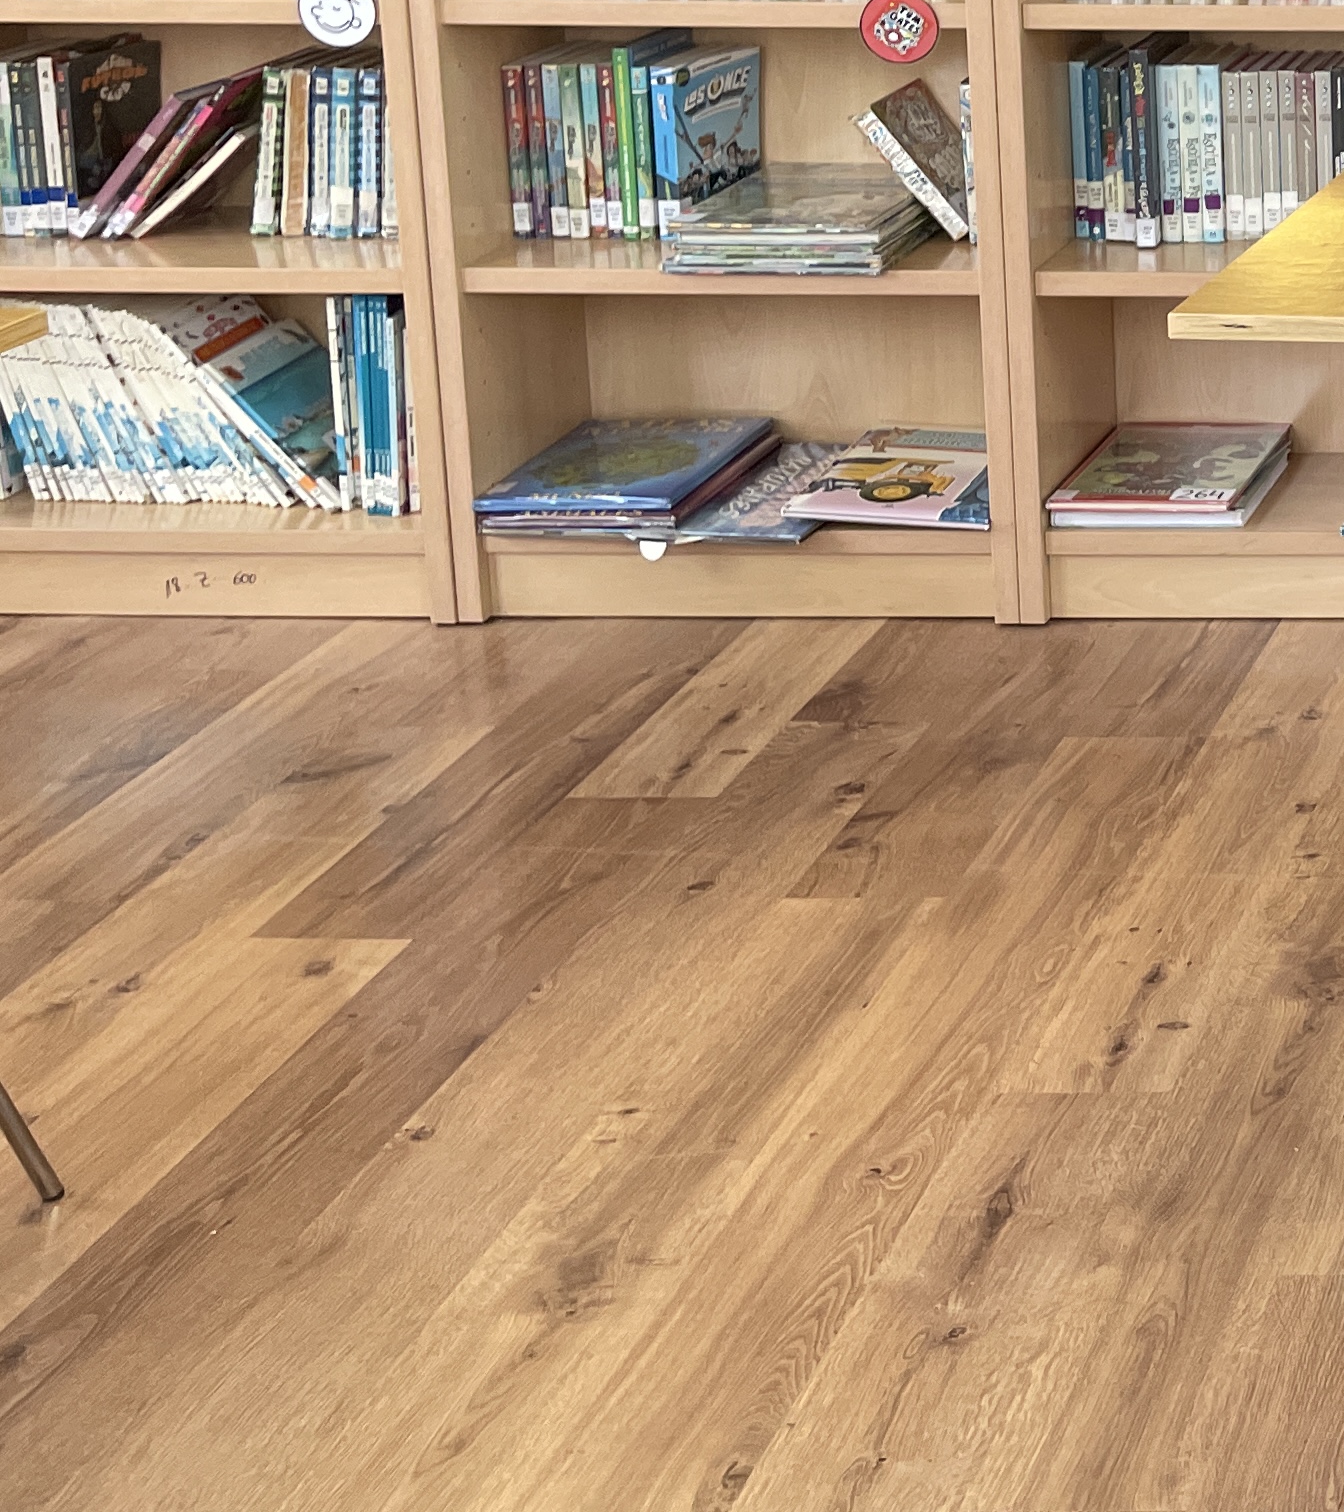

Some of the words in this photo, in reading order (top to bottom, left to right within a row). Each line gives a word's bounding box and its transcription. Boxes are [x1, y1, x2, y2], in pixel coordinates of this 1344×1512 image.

[684, 84, 706, 112] LOS
[707, 65, 752, 100] ONCE
[1175, 489, 1225, 500] 264
[233, 571, 257, 585] 600
